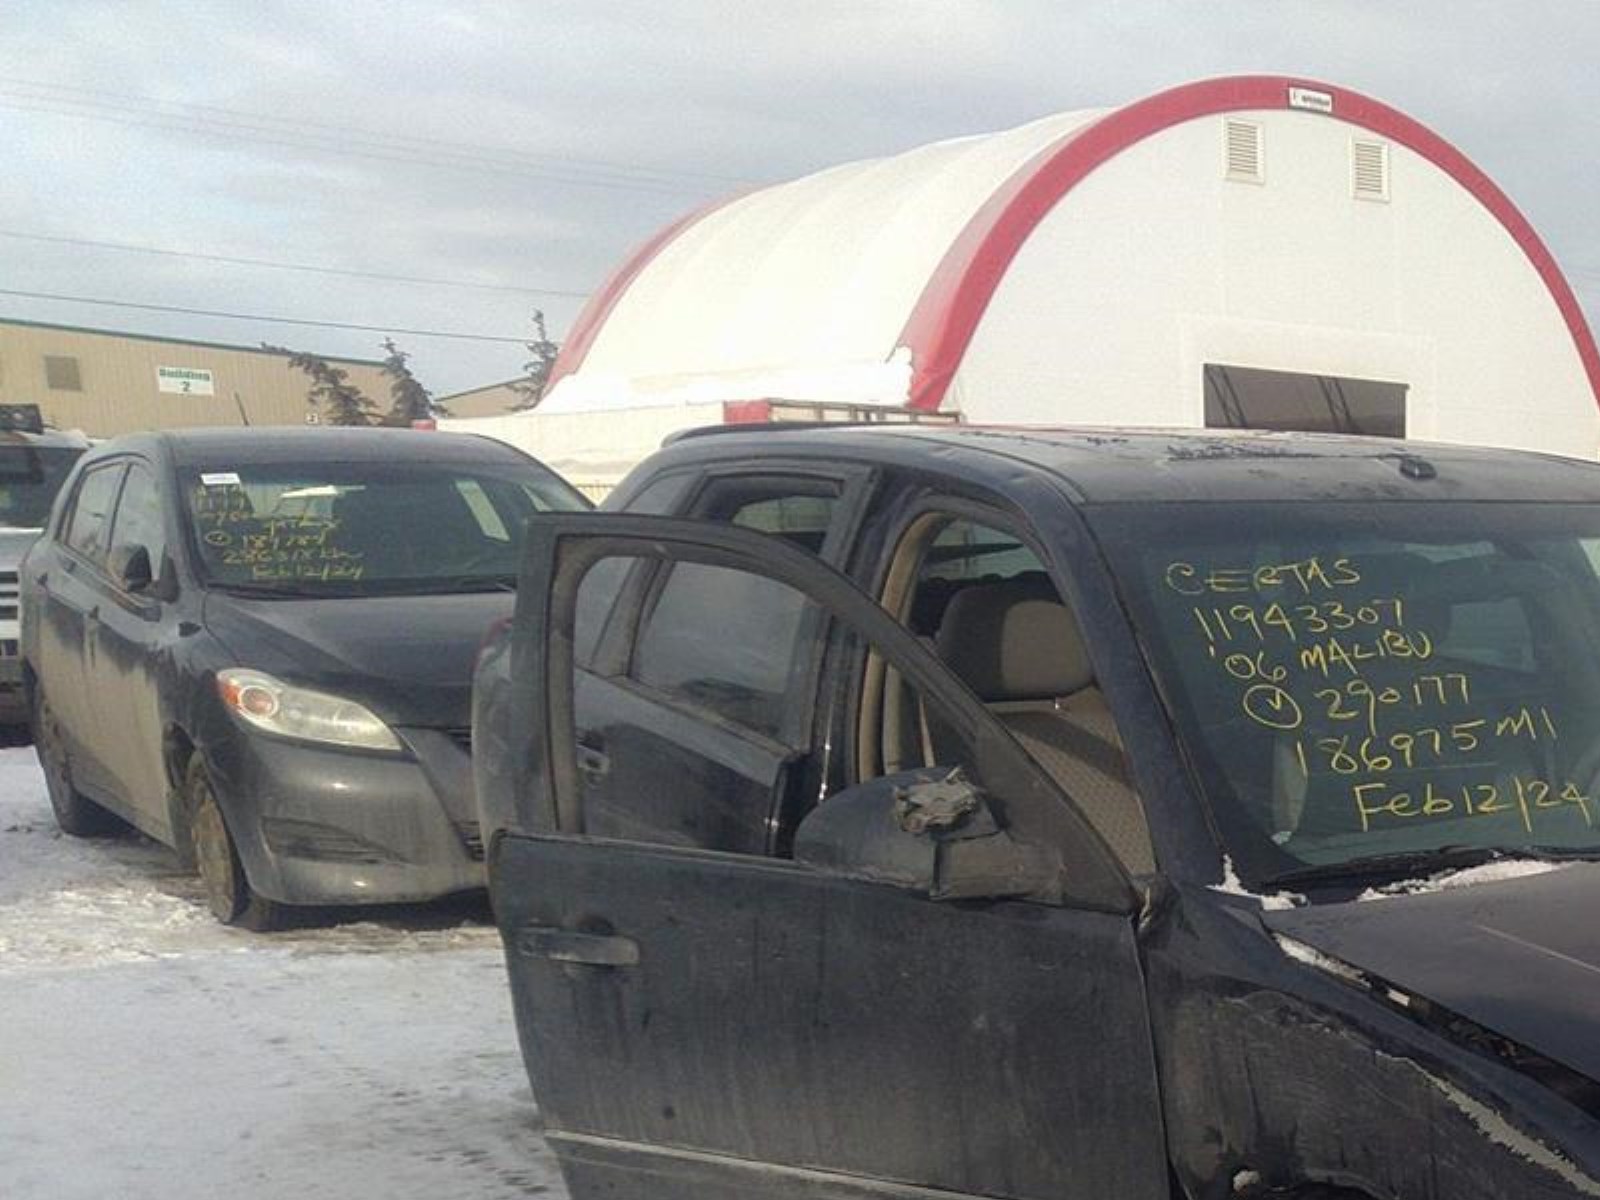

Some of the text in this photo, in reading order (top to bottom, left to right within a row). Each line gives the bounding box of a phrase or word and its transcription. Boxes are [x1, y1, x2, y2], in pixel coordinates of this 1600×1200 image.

[1167, 558, 1361, 595] CERTAS
[1194, 600, 1402, 641] 11943307
[1301, 631, 1432, 678] MALIBU
[1314, 674, 1470, 734] 290177
[1296, 720, 1486, 776] 186975
